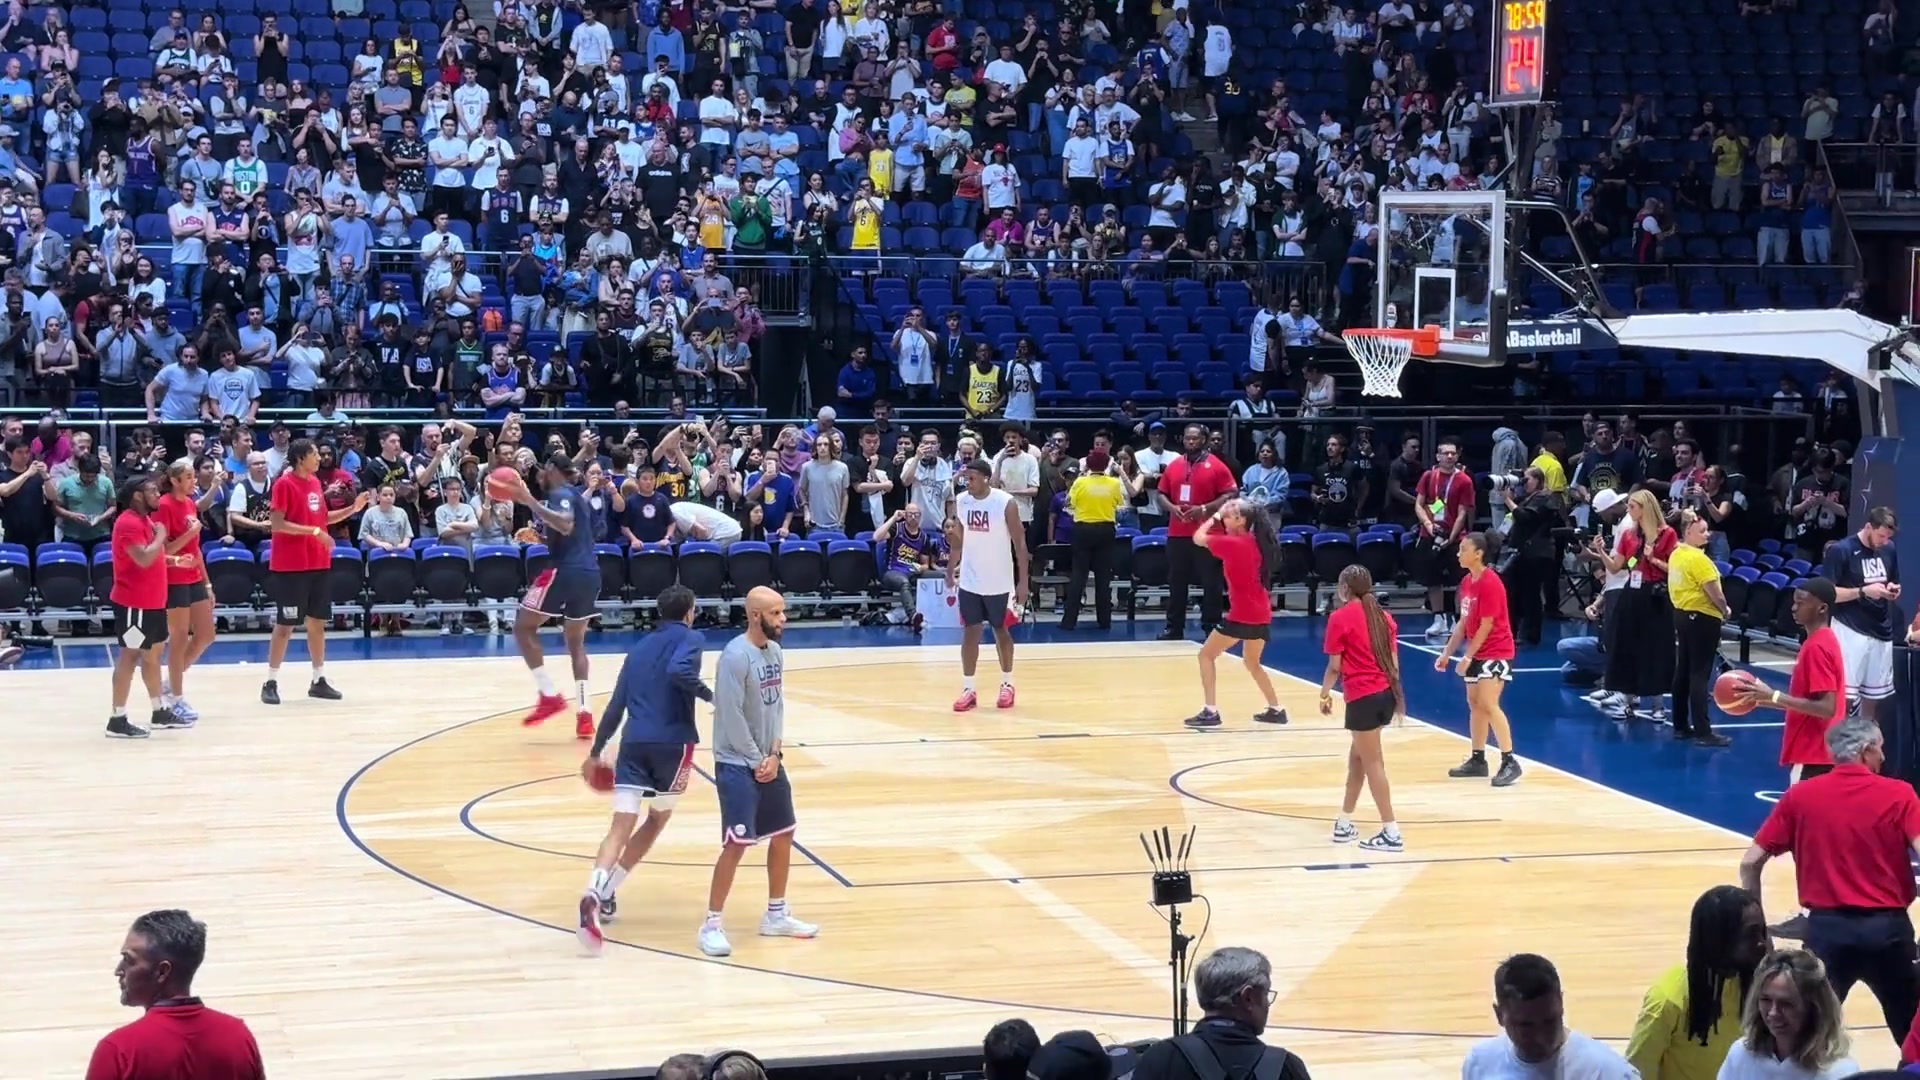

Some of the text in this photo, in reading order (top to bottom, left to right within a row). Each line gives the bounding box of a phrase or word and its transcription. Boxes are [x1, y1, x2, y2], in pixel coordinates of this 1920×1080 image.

[1506, 35, 1540, 92] 24
[240, 181, 250, 194] 0
[500, 209, 509, 224] 6
[1015, 380, 1030, 393] 23
[977, 391, 992, 404] 23
[1325, 477, 1348, 485] TOWN
[671, 483, 685, 497] 30
[967, 510, 989, 527] USA
[1862, 557, 1887, 578] USA
[758, 664, 782, 682] USA
